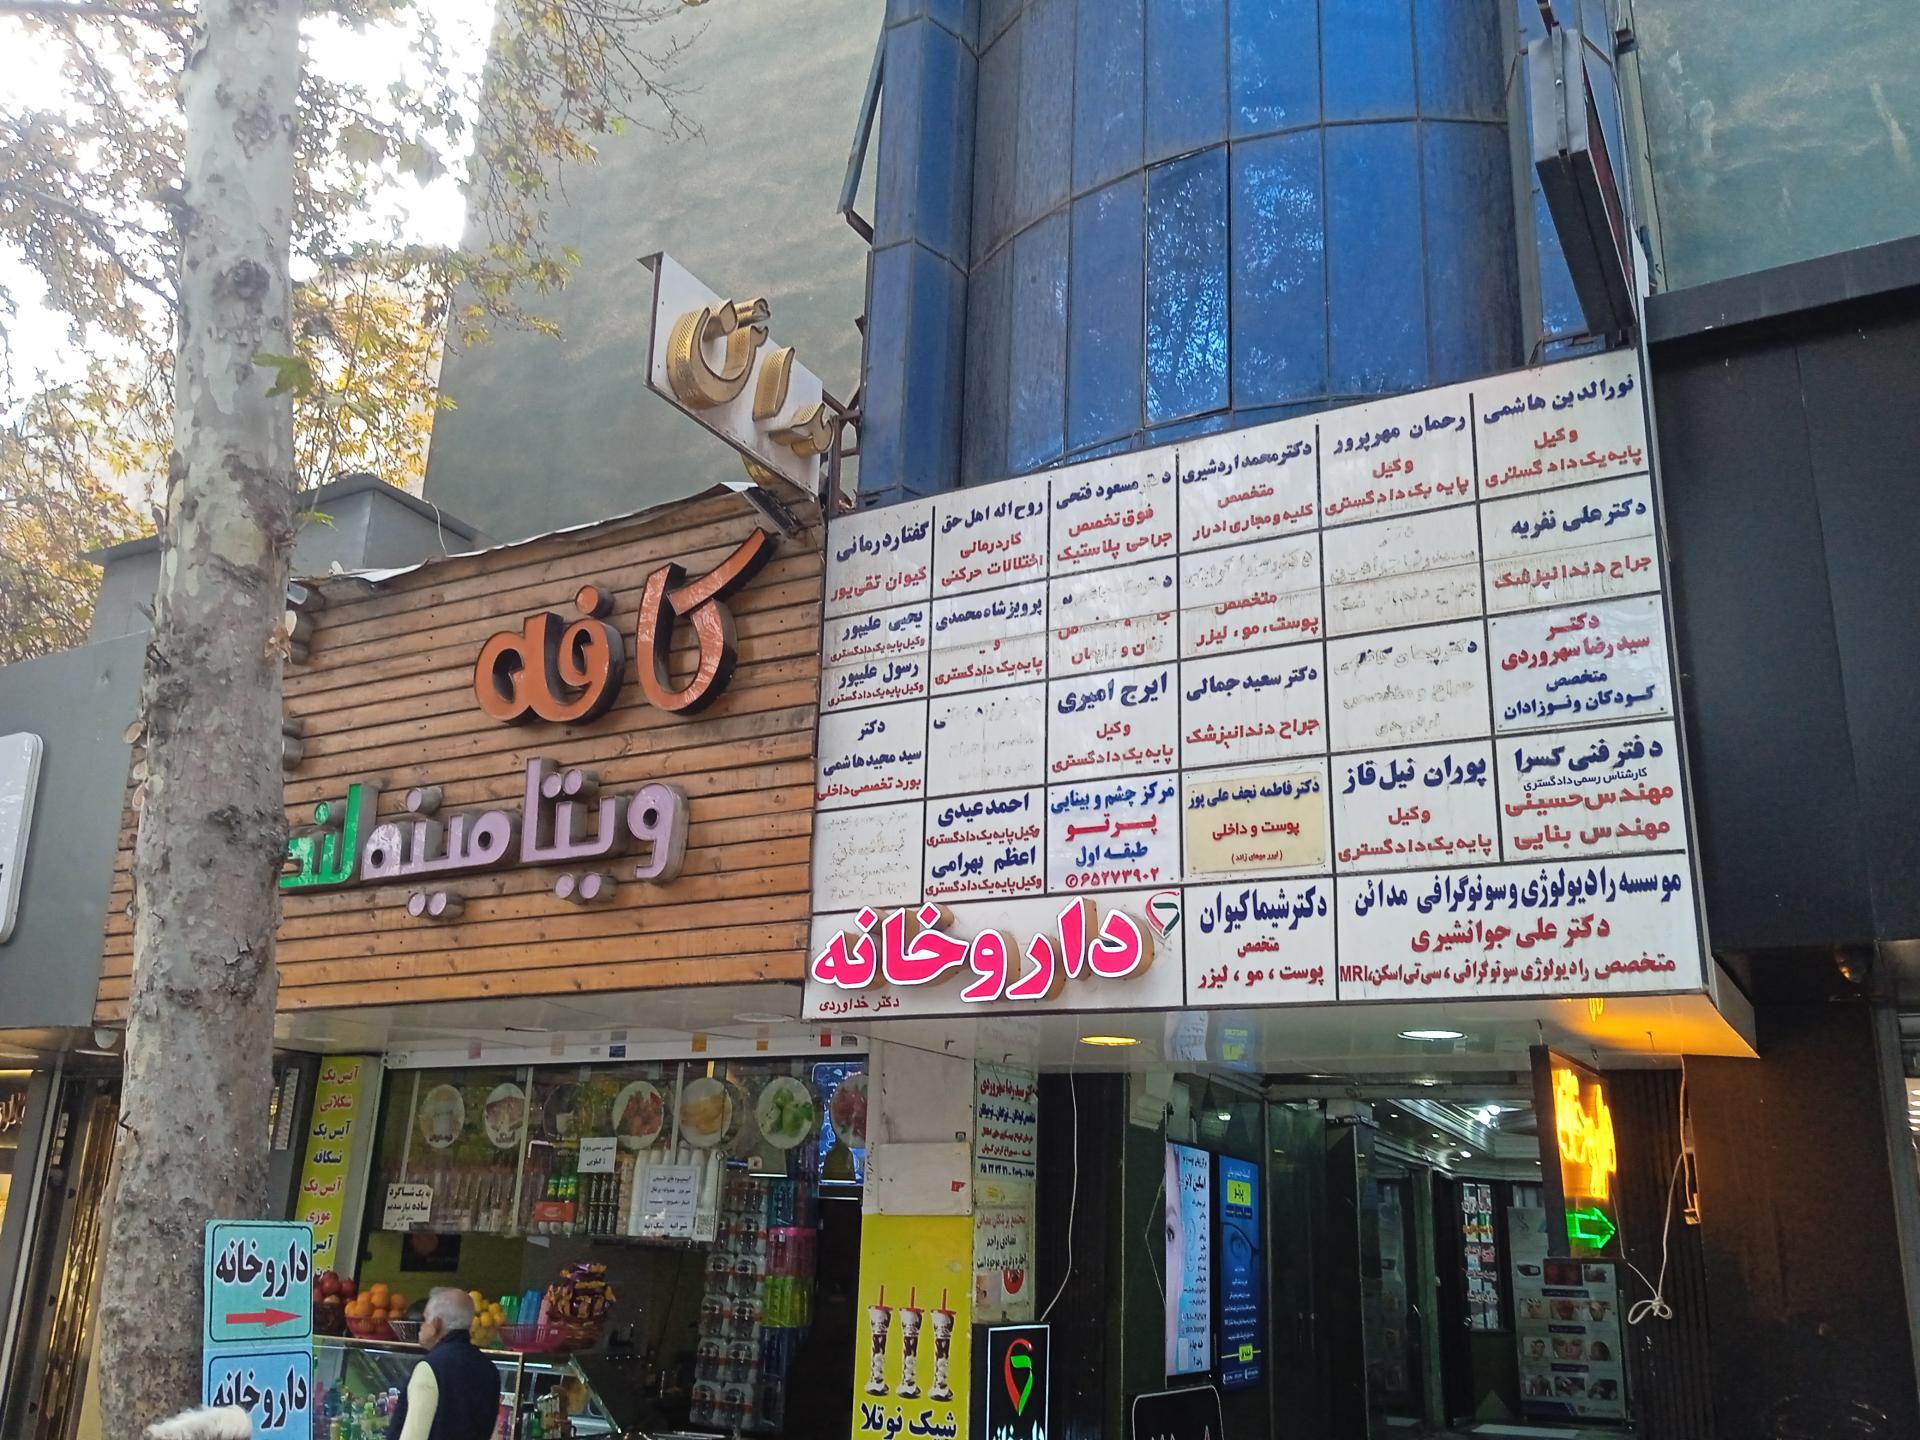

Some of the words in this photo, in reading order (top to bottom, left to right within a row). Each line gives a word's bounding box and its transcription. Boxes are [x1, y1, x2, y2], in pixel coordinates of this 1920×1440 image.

[1552, 374, 1634, 410] نورالدین
[1484, 394, 1546, 424] هاشمی
[1410, 415, 1465, 439] رحمان
[1534, 428, 1578, 449] وکیل
[1333, 427, 1400, 455] مهرپرور
[1241, 453, 1278, 468] محمد
[1277, 440, 1312, 466] دکتر
[1373, 458, 1413, 479] وکیل
[1056, 486, 1092, 510] فتحی
[1096, 481, 1138, 501] مسعود
[1218, 484, 1274, 509] متخصص
[965, 505, 989, 528] اهل
[1014, 502, 1043, 520] روح
[1122, 504, 1153, 527] فوق
[1283, 503, 1313, 523] کلیه
[1563, 505, 1602, 532] علی
[1604, 499, 1646, 526] دکتر
[942, 515, 962, 534] حق
[1069, 512, 1120, 537] تخصص
[1192, 520, 1226, 541] ادرار
[1229, 515, 1271, 533] مجاری
[1057, 539, 1120, 564] پلاستیک
[1126, 532, 1172, 552] جراحی
[886, 566, 926, 591] کیوان
[1610, 556, 1651, 578] جراح
[1006, 598, 1042, 620] پرویز
[1215, 592, 1277, 615] متخصص
[474, 527, 770, 724] کافه
[888, 611, 923, 631] یحیی
[1546, 612, 1600, 641] دکتر
[902, 635, 925, 648] وکیل
[1196, 626, 1227, 647] لیزر
[1583, 637, 1613, 659] رضا
[1617, 636, 1650, 655] سید
[1502, 646, 1580, 671] سهروردی
[883, 662, 918, 683] رسول
[1243, 675, 1281, 692] سعید
[1284, 666, 1317, 688] دکتر
[1546, 669, 1607, 692] متخصص
[902, 682, 924, 695] وکیل
[1058, 678, 1114, 714] امیری
[1121, 671, 1167, 707] ایرج
[1187, 675, 1240, 701] جمالی
[1586, 684, 1655, 711] کودکان
[857, 720, 885, 741] دکتر
[1097, 721, 1131, 741] وکیل
[1279, 719, 1319, 739] جراح
[866, 754, 895, 769] مجید
[899, 750, 921, 765] سید
[1515, 744, 1565, 772] کسرا
[1568, 739, 1609, 771] فنی
[1611, 734, 1663, 769] دفتر
[823, 754, 864, 776] هاشمی
[1379, 758, 1415, 790] نیل
[1424, 754, 1487, 787] پوران
[1603, 768, 1647, 783] کارشناس
[818, 784, 849, 800] داخلی
[851, 777, 893, 797] تخصصی
[896, 779, 921, 791] بورد
[1260, 780, 1292, 797] فاطمه
[1294, 779, 1320, 799] دکتر
[1524, 775, 1572, 791] دادگستری
[1574, 776, 1601, 786] رسمی
[986, 792, 1029, 815] احمد
[1051, 789, 1090, 815] بینایی
[1105, 785, 1136, 809] چشم
[1140, 781, 1175, 806] مرکز
[1188, 790, 1205, 810] پور
[1207, 788, 1229, 807] علی
[1232, 784, 1257, 803] نجف
[1505, 793, 1583, 817] حسینی
[1584, 783, 1673, 810] مهندس
[938, 802, 983, 827] عیدی
[1388, 806, 1430, 826] وکیل
[1015, 824, 1040, 841] وکیل
[1213, 823, 1247, 841] داخلی
[1261, 822, 1299, 836] پوست
[1514, 825, 1571, 850] بنایی
[1580, 818, 1670, 845] مهندس
[994, 845, 1035, 874] اعظم
[1076, 845, 1100, 867] اول
[1104, 841, 1148, 862] طبقه
[932, 852, 983, 878] بهرامی
[1016, 875, 1042, 891] وکیل
[1619, 866, 1682, 902] موسسه
[1252, 888, 1289, 928] شیما
[1288, 885, 1327, 930] دکتر
[1355, 879, 1407, 916] مدائن
[1200, 889, 1250, 934] کیوان
[1412, 920, 1511, 953] جوانشیری
[1516, 917, 1557, 948] علی
[1563, 914, 1610, 948] دکتر
[811, 896, 1143, 1003] داروخانه
[1237, 935, 1279, 958] متخصص
[1198, 964, 1228, 989] لیزر
[1595, 952, 1676, 980] متخصص
[819, 997, 868, 1014] خداوردی
[873, 996, 900, 1012] دکتر
[330, 1121, 352, 1140] آیس
[313, 1150, 342, 1164] نسکافه
[320, 1177, 341, 1196] آیس
[215, 1239, 309, 1298] داروخانه
[908, 1411, 957, 1440] شیک
